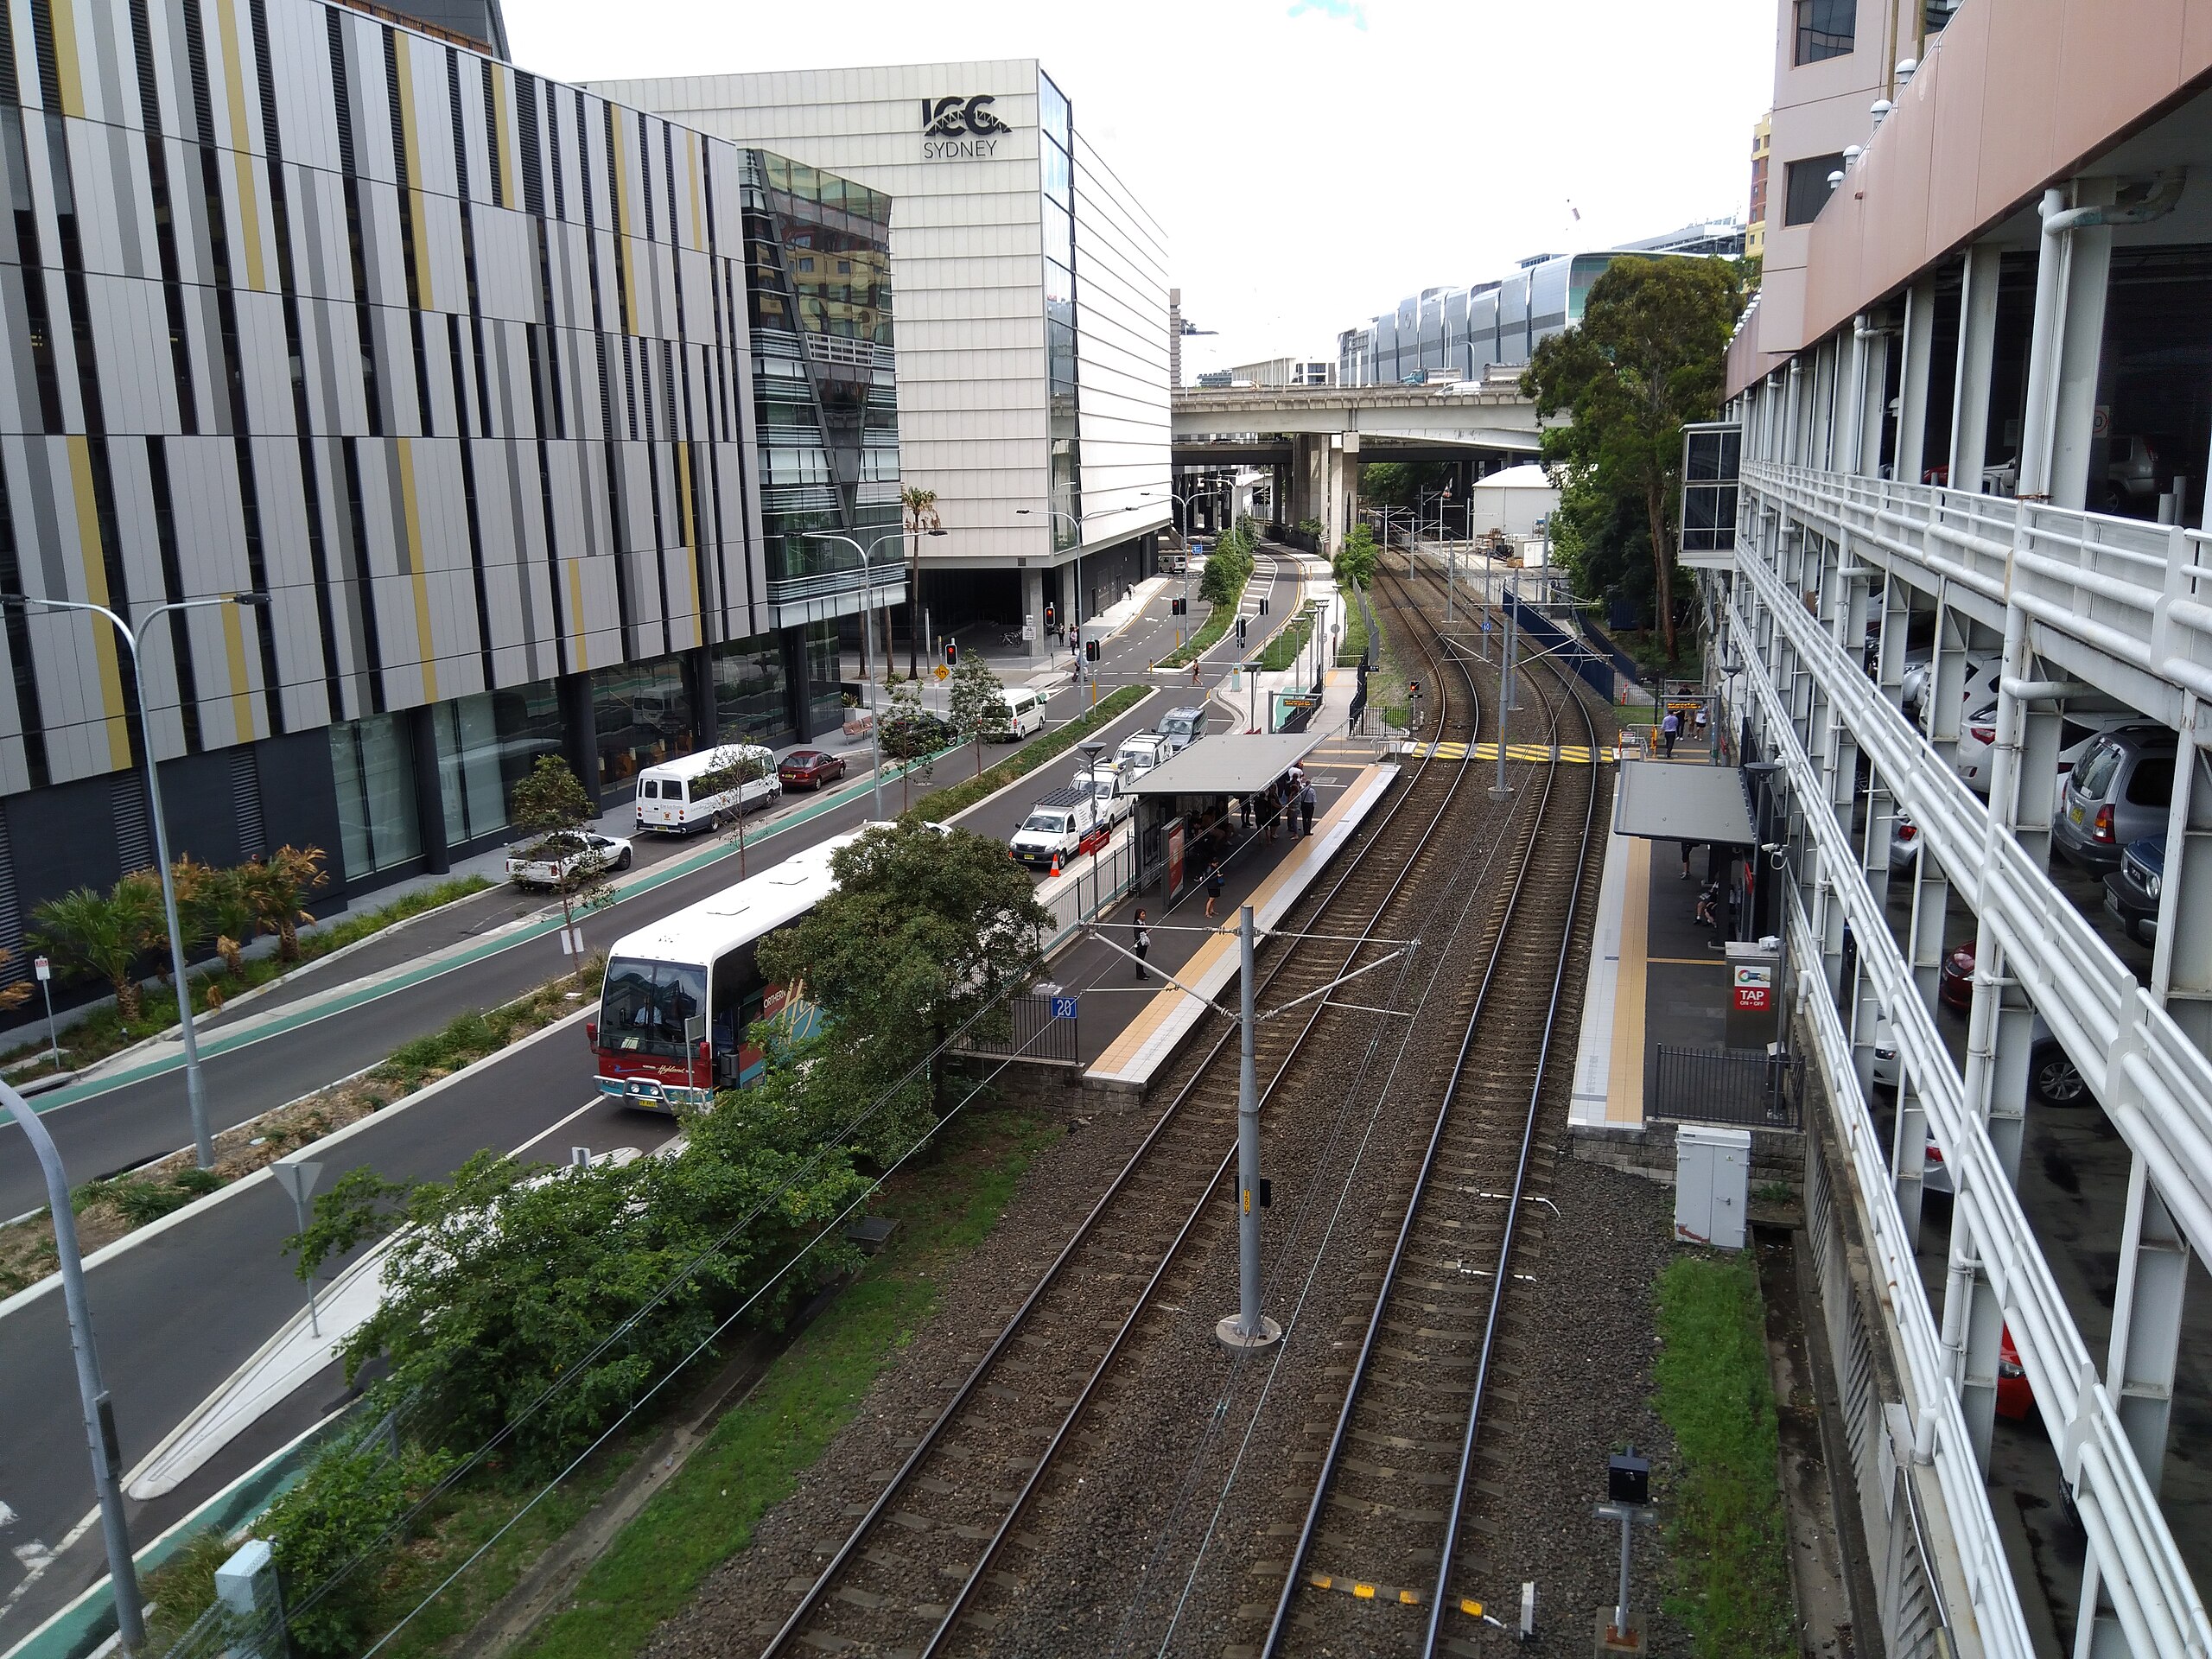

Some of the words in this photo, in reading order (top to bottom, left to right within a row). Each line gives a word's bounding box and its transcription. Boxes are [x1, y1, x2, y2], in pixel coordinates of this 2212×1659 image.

[921, 95, 1009, 137] ICC
[924, 140, 997, 159] SYDNEY
[763, 990, 786, 1008] ORTHERN
[1739, 990, 1764, 1001] TAP
[1057, 999, 1071, 1017] 20
[658, 1065, 685, 1075] Highland
